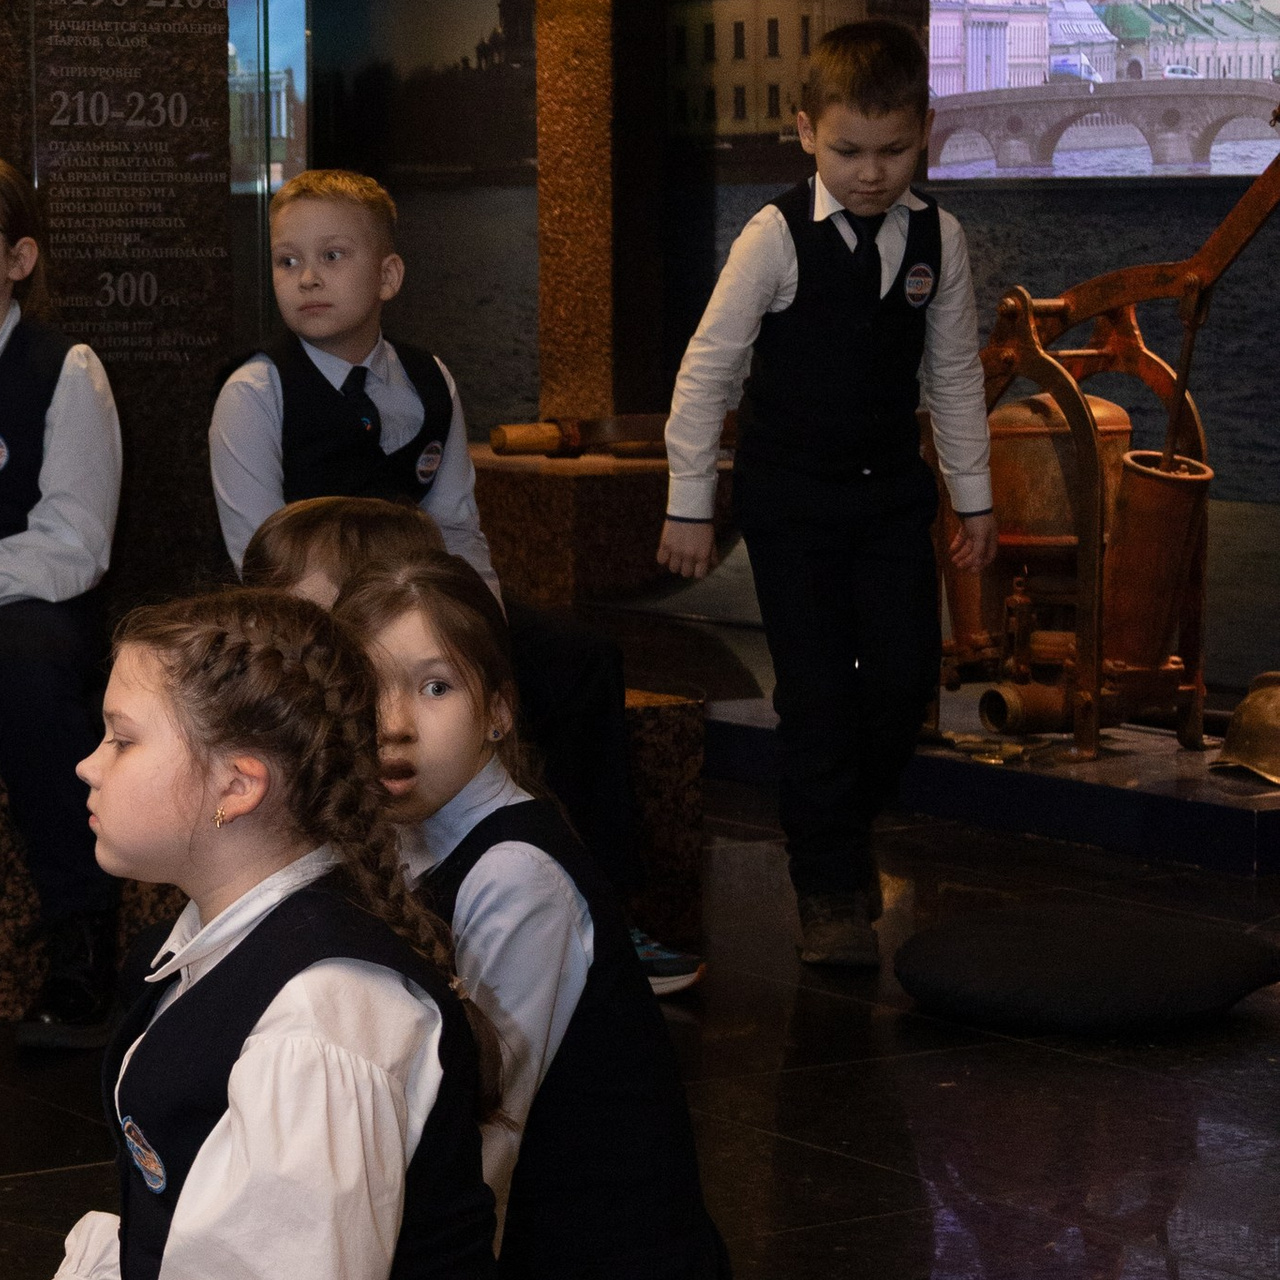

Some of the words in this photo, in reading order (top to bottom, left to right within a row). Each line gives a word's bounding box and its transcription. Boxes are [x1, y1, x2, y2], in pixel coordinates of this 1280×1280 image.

[48, 20, 138, 33] НАЧИНАЕТСЯ
[139, 22, 226, 35] ЗАТОПЛЕНИЕ
[59, 66, 87, 78] ПРИ
[89, 66, 143, 79] УРОВНЕ
[49, 90, 188, 128] 210-230
[48, 140, 131, 152] ОТДЕЛЬНЫХ
[49, 172, 65, 183] ЗА
[67, 172, 111, 183] ВРЕМЯ
[112, 172, 227, 184] СУЩЕСТВОВАНИЯ
[48, 186, 177, 199] САНКТ-ПЕТЕРБУРГА
[49, 201, 135, 213] ПРОИЗОШЛО
[137, 202, 162, 213] ТРИ
[49, 217, 186, 229] КАТАСТРОФИЧЕСКИХ
[50, 247, 92, 259] КОГДА
[94, 247, 129, 259] ВОДА
[131, 246, 228, 259] ПОДНИМАЛАСЬ
[95, 271, 159, 307] 300
